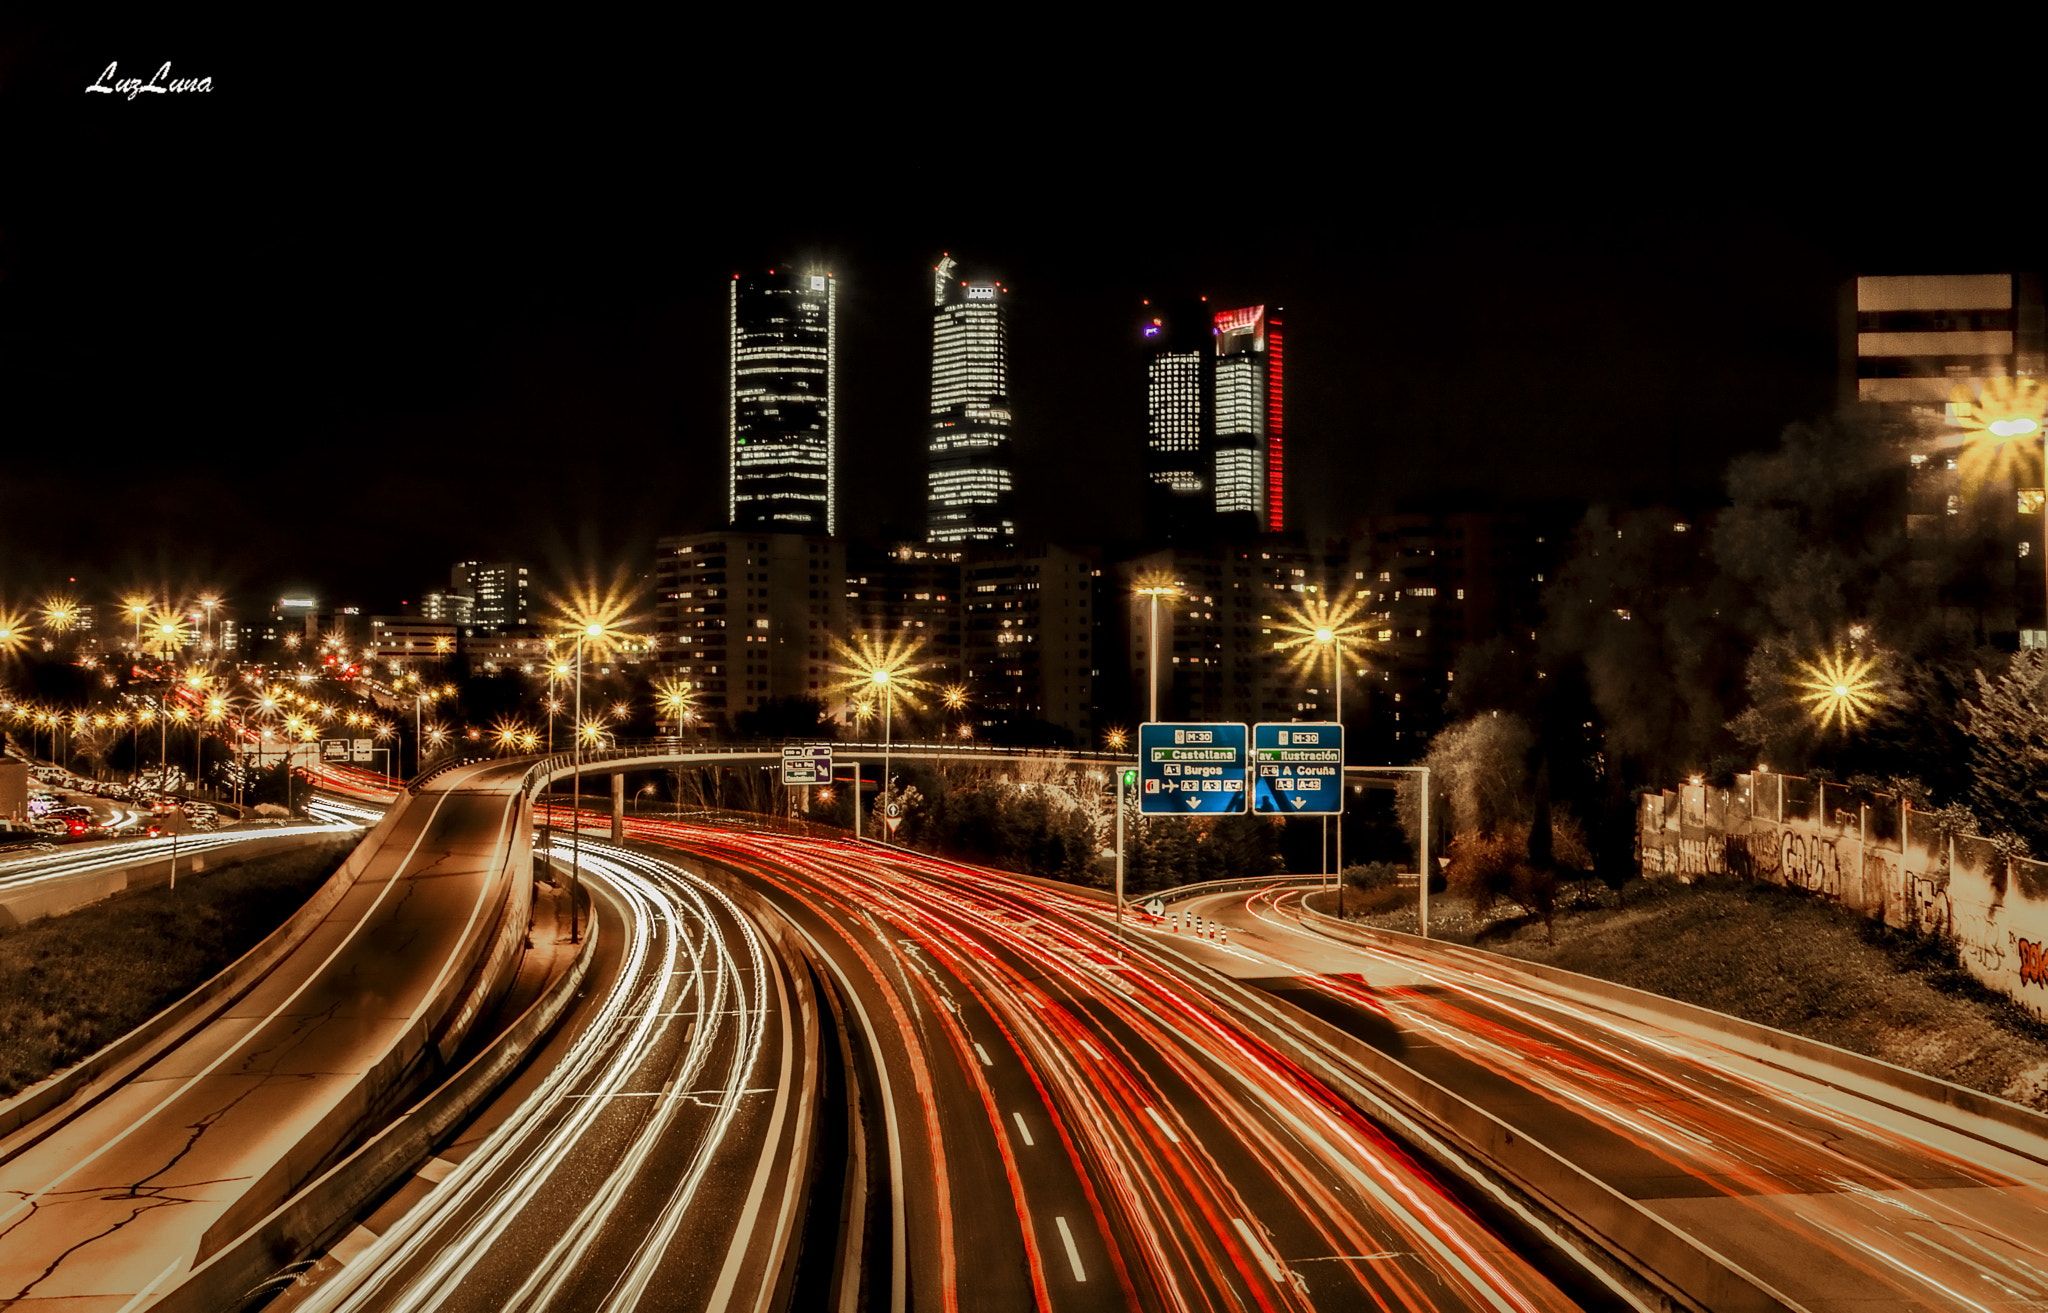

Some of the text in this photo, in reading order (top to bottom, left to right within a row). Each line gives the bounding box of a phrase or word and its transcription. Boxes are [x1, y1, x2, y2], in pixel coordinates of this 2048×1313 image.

[1172, 750, 1234, 760] Castellana
[1259, 752, 1274, 760] av.
[1184, 765, 1223, 778] Burgos
[1282, 766, 1292, 776] A
[1296, 765, 1336, 776] Coruña
